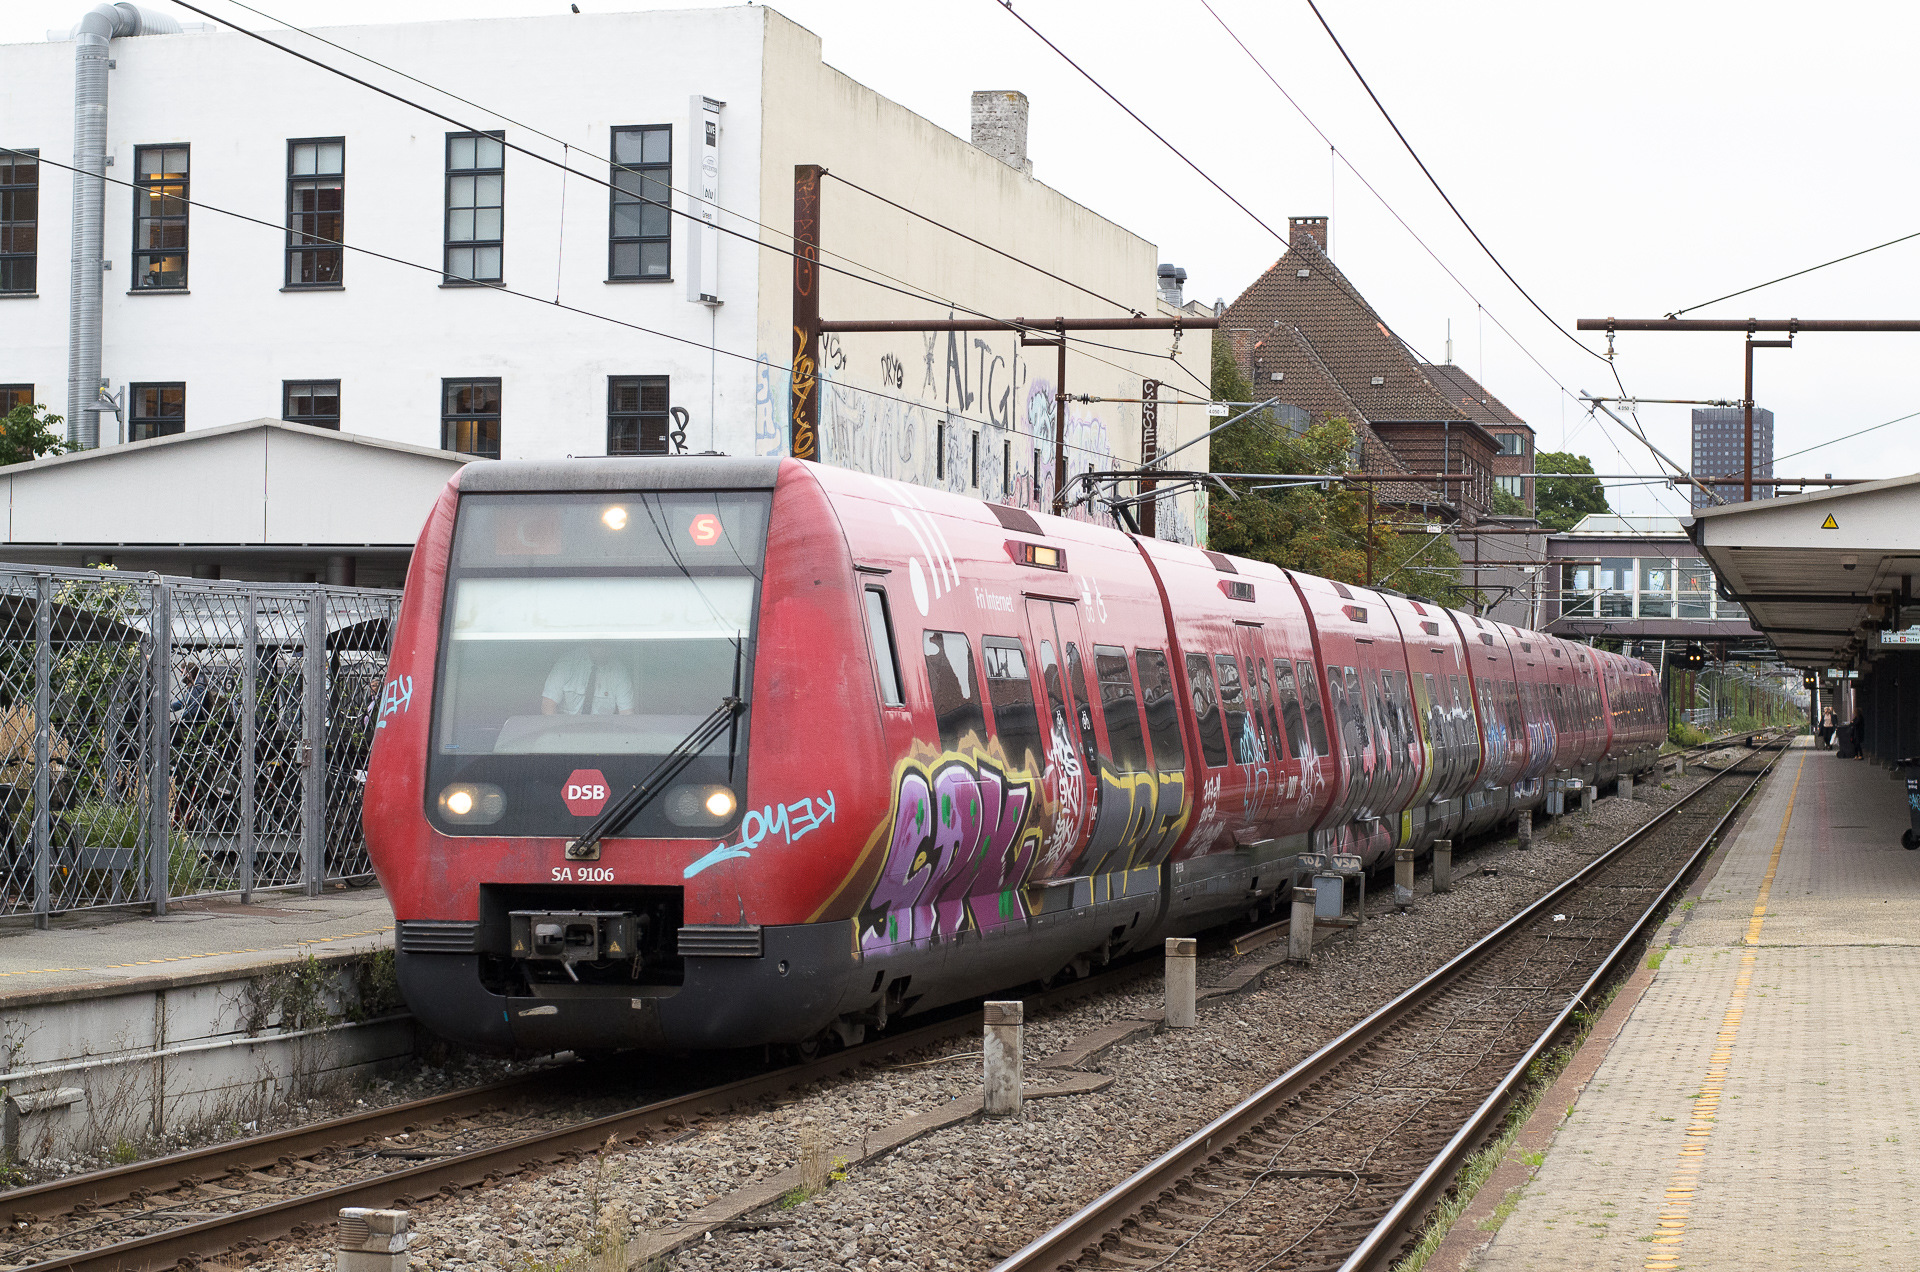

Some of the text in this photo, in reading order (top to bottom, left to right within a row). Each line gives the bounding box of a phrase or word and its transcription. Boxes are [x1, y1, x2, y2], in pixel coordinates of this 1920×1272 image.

[696, 519, 715, 540] S
[974, 587, 1015, 613] Fri Internet
[568, 785, 605, 800] DSB
[551, 867, 615, 882] SA 9106
